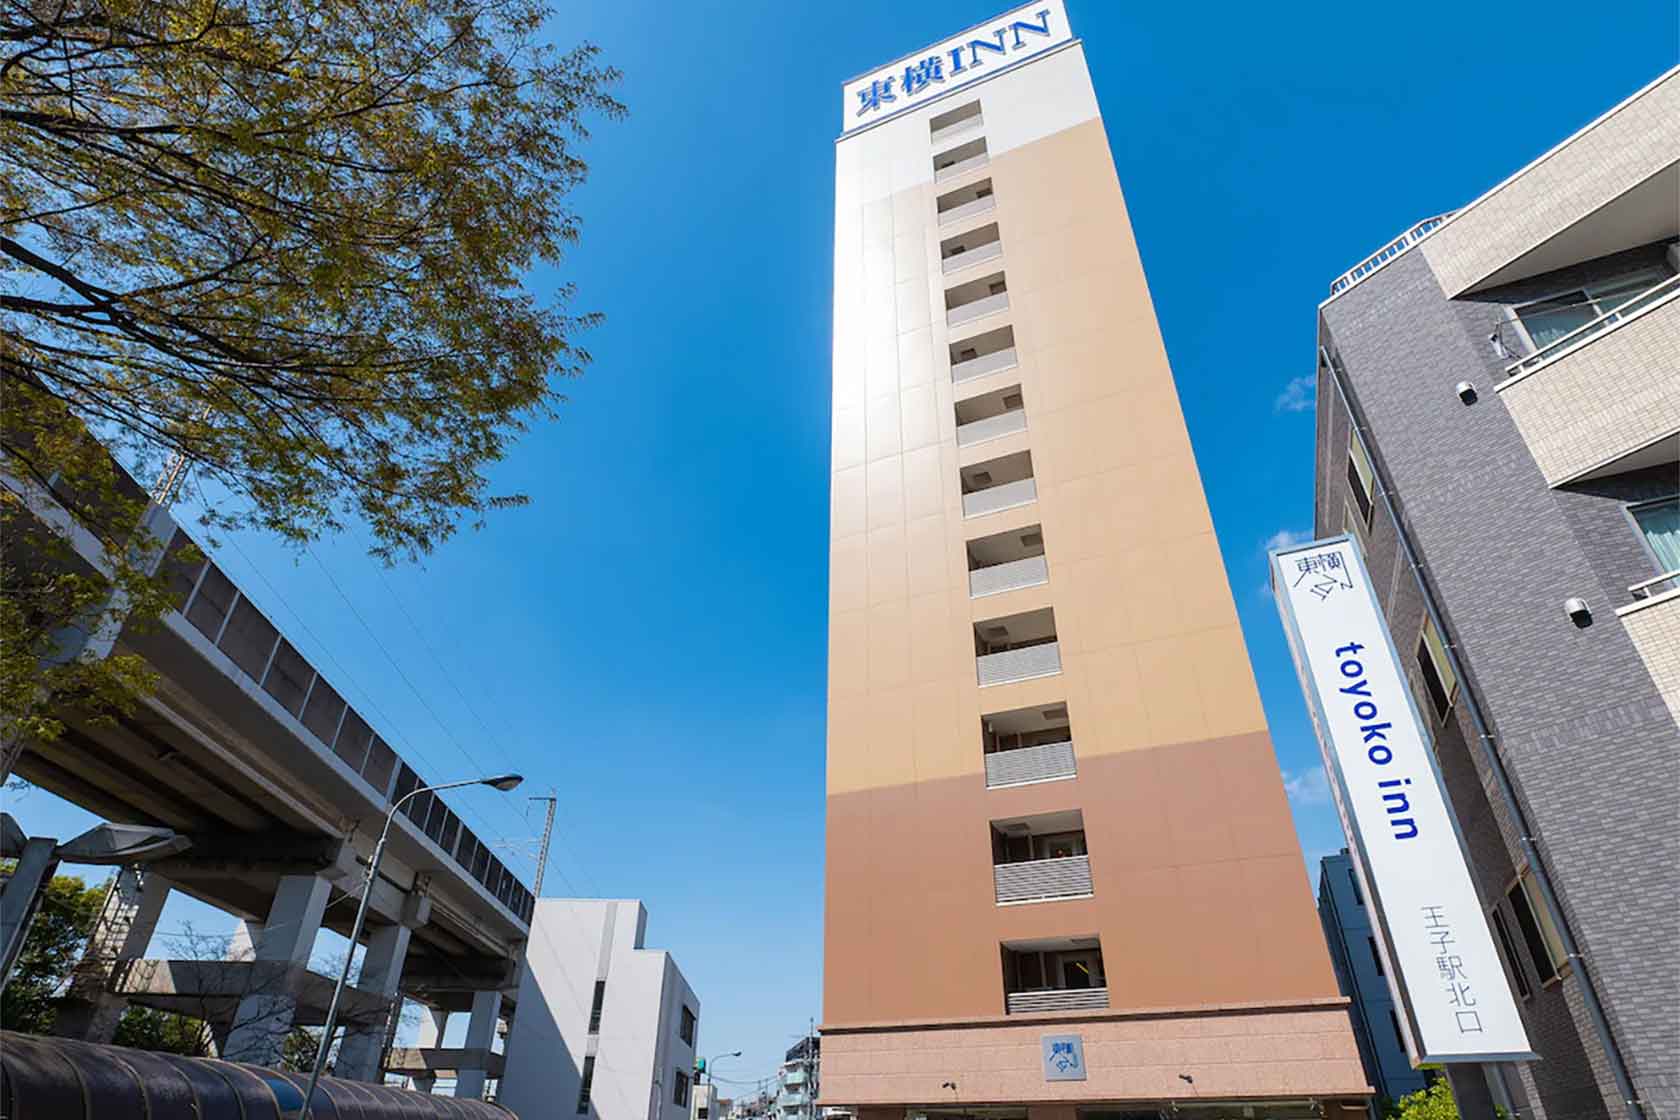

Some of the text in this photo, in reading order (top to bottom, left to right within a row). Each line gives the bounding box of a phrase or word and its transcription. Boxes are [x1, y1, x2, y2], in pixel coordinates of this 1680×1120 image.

[1335, 642, 1419, 840] toyoko inn
[1421, 906, 1483, 1033] 王子駅北口
